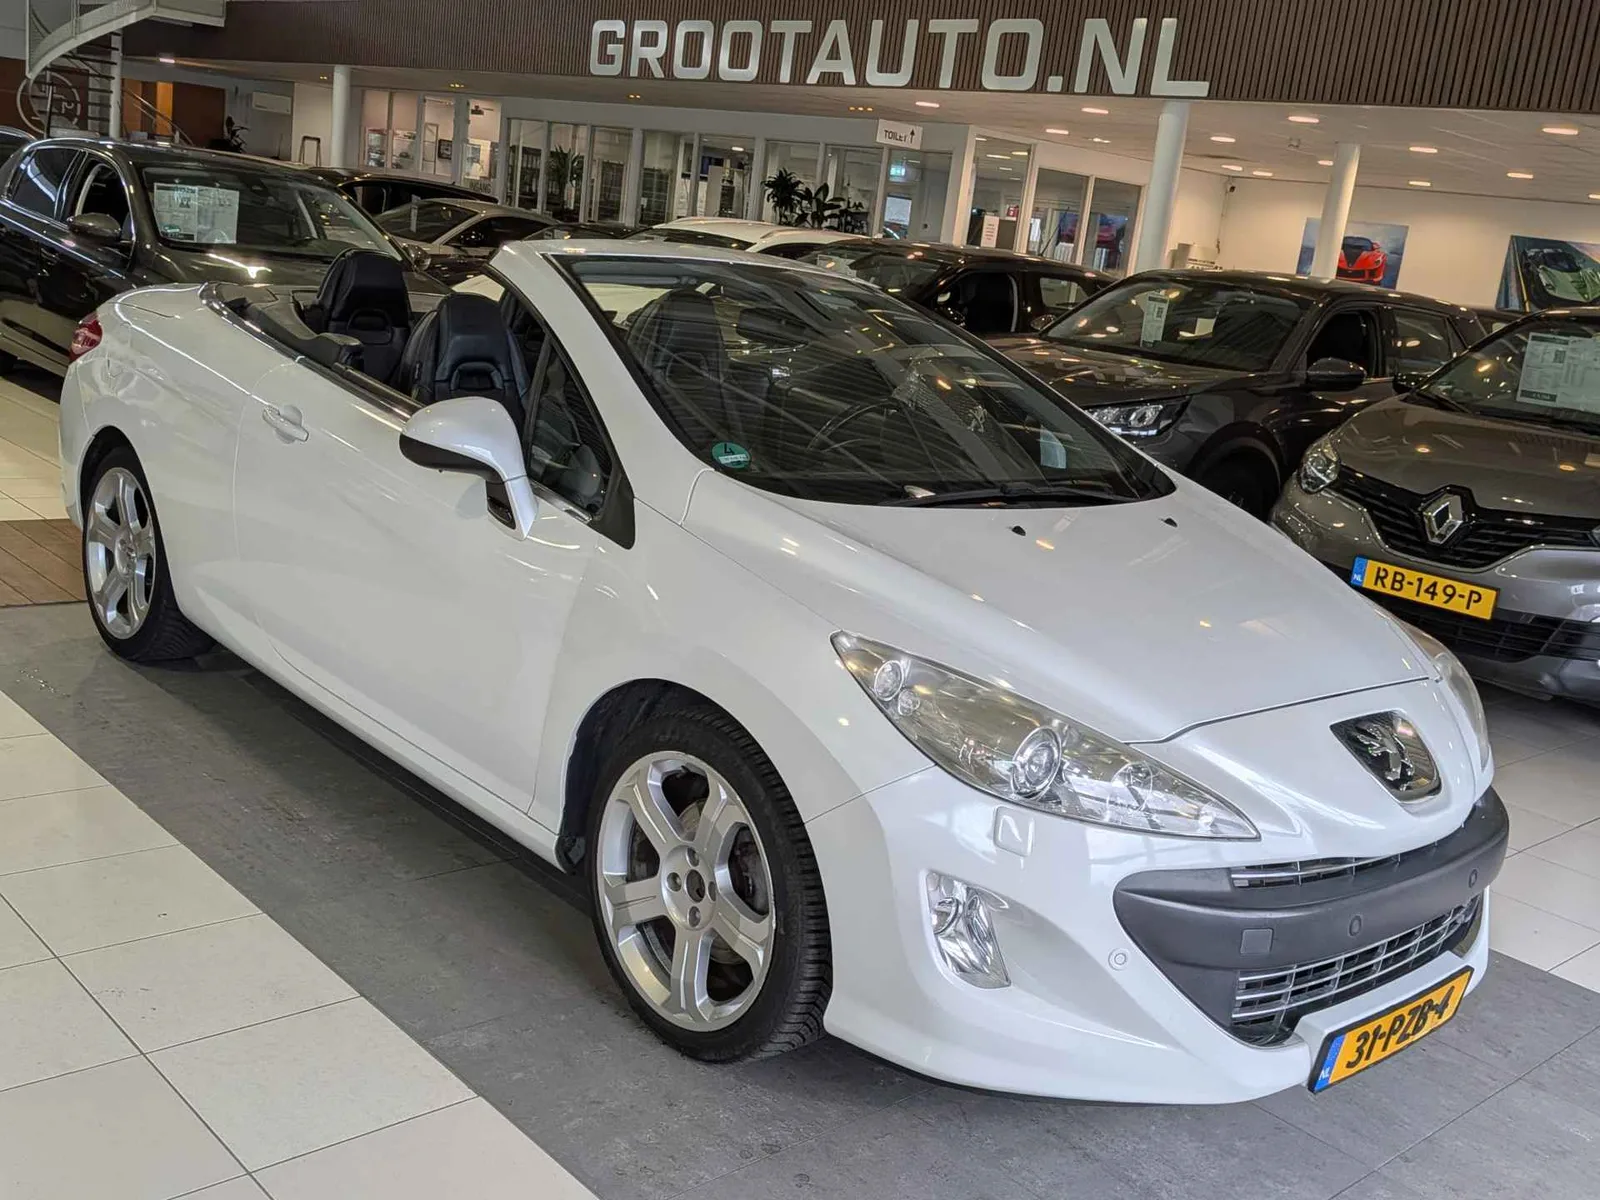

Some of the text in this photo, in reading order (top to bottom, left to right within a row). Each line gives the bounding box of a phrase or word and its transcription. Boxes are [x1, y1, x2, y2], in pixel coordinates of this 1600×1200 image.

[589, 17, 1210, 97] GROOTAUTO.NL
[1353, 574, 1363, 583] NL
[1373, 566, 1483, 611] RB-149-P
[1345, 985, 1456, 1069] 31-PZB-4
[1318, 1066, 1331, 1081] NL
